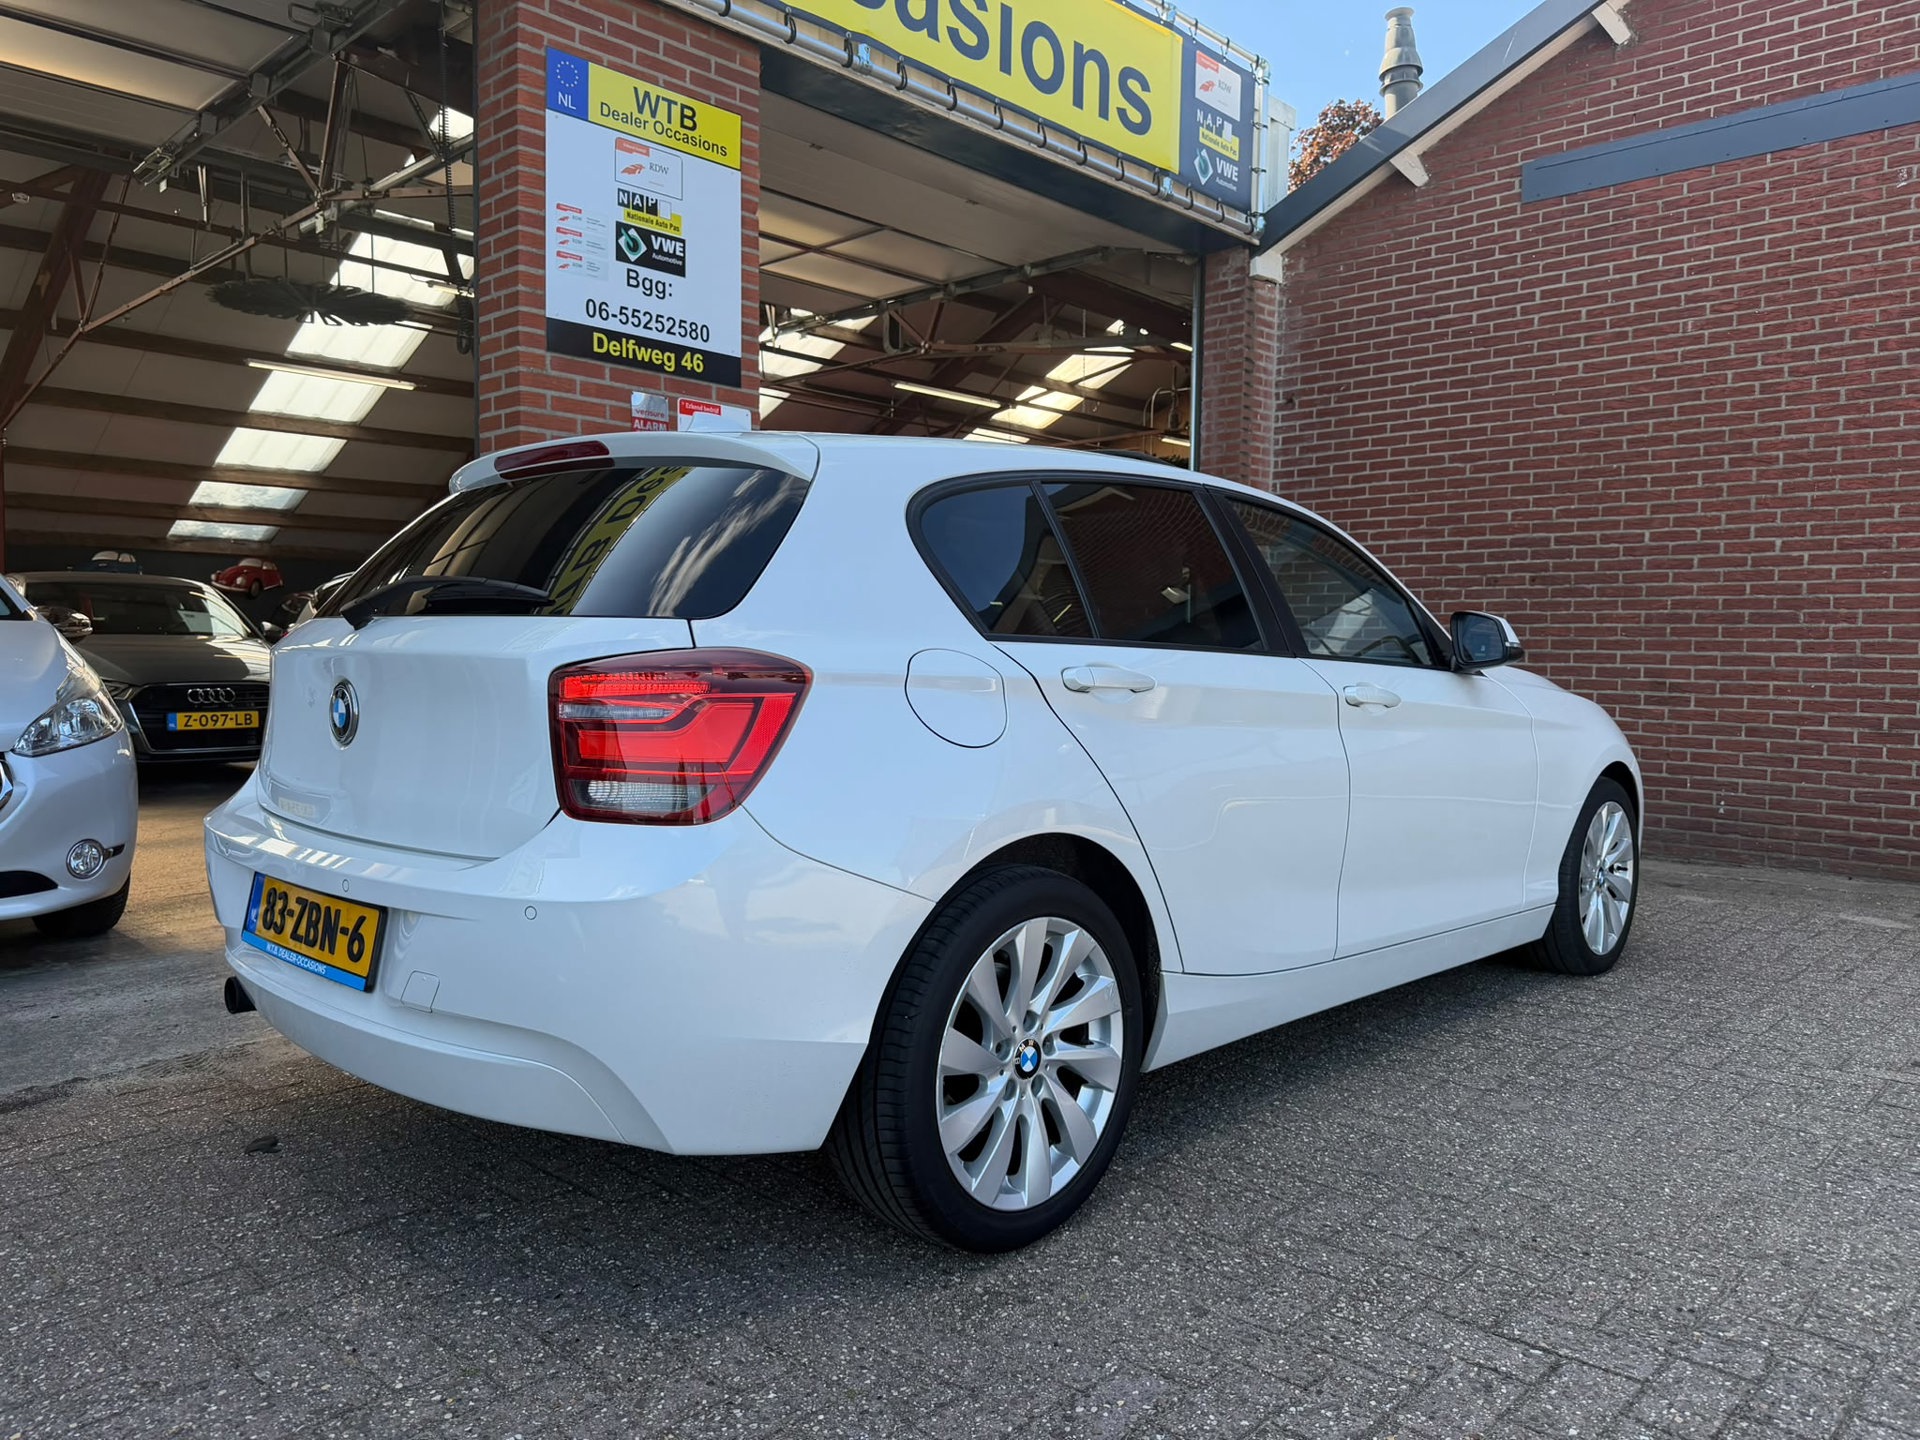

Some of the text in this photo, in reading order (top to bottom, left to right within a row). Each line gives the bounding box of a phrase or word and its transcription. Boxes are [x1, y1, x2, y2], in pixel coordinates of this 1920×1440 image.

[853, 0, 1152, 136] asions
[558, 91, 577, 110] NL
[633, 86, 698, 132] WTB
[600, 101, 728, 157] Dealer Occasions
[648, 162, 670, 175] RDW
[1216, 157, 1239, 182] VWE
[626, 210, 680, 232] Nationale Auto Pas
[651, 234, 684, 257] VWE
[652, 252, 683, 266] Automotive
[626, 267, 673, 300] Bgg:
[585, 298, 711, 343] 06-55252580
[592, 331, 705, 373] Delfweg 46
[633, 418, 668, 432] ALARM
[183, 713, 254, 728] Z-097-LB
[262, 886, 367, 963] 83-ZBN-6
